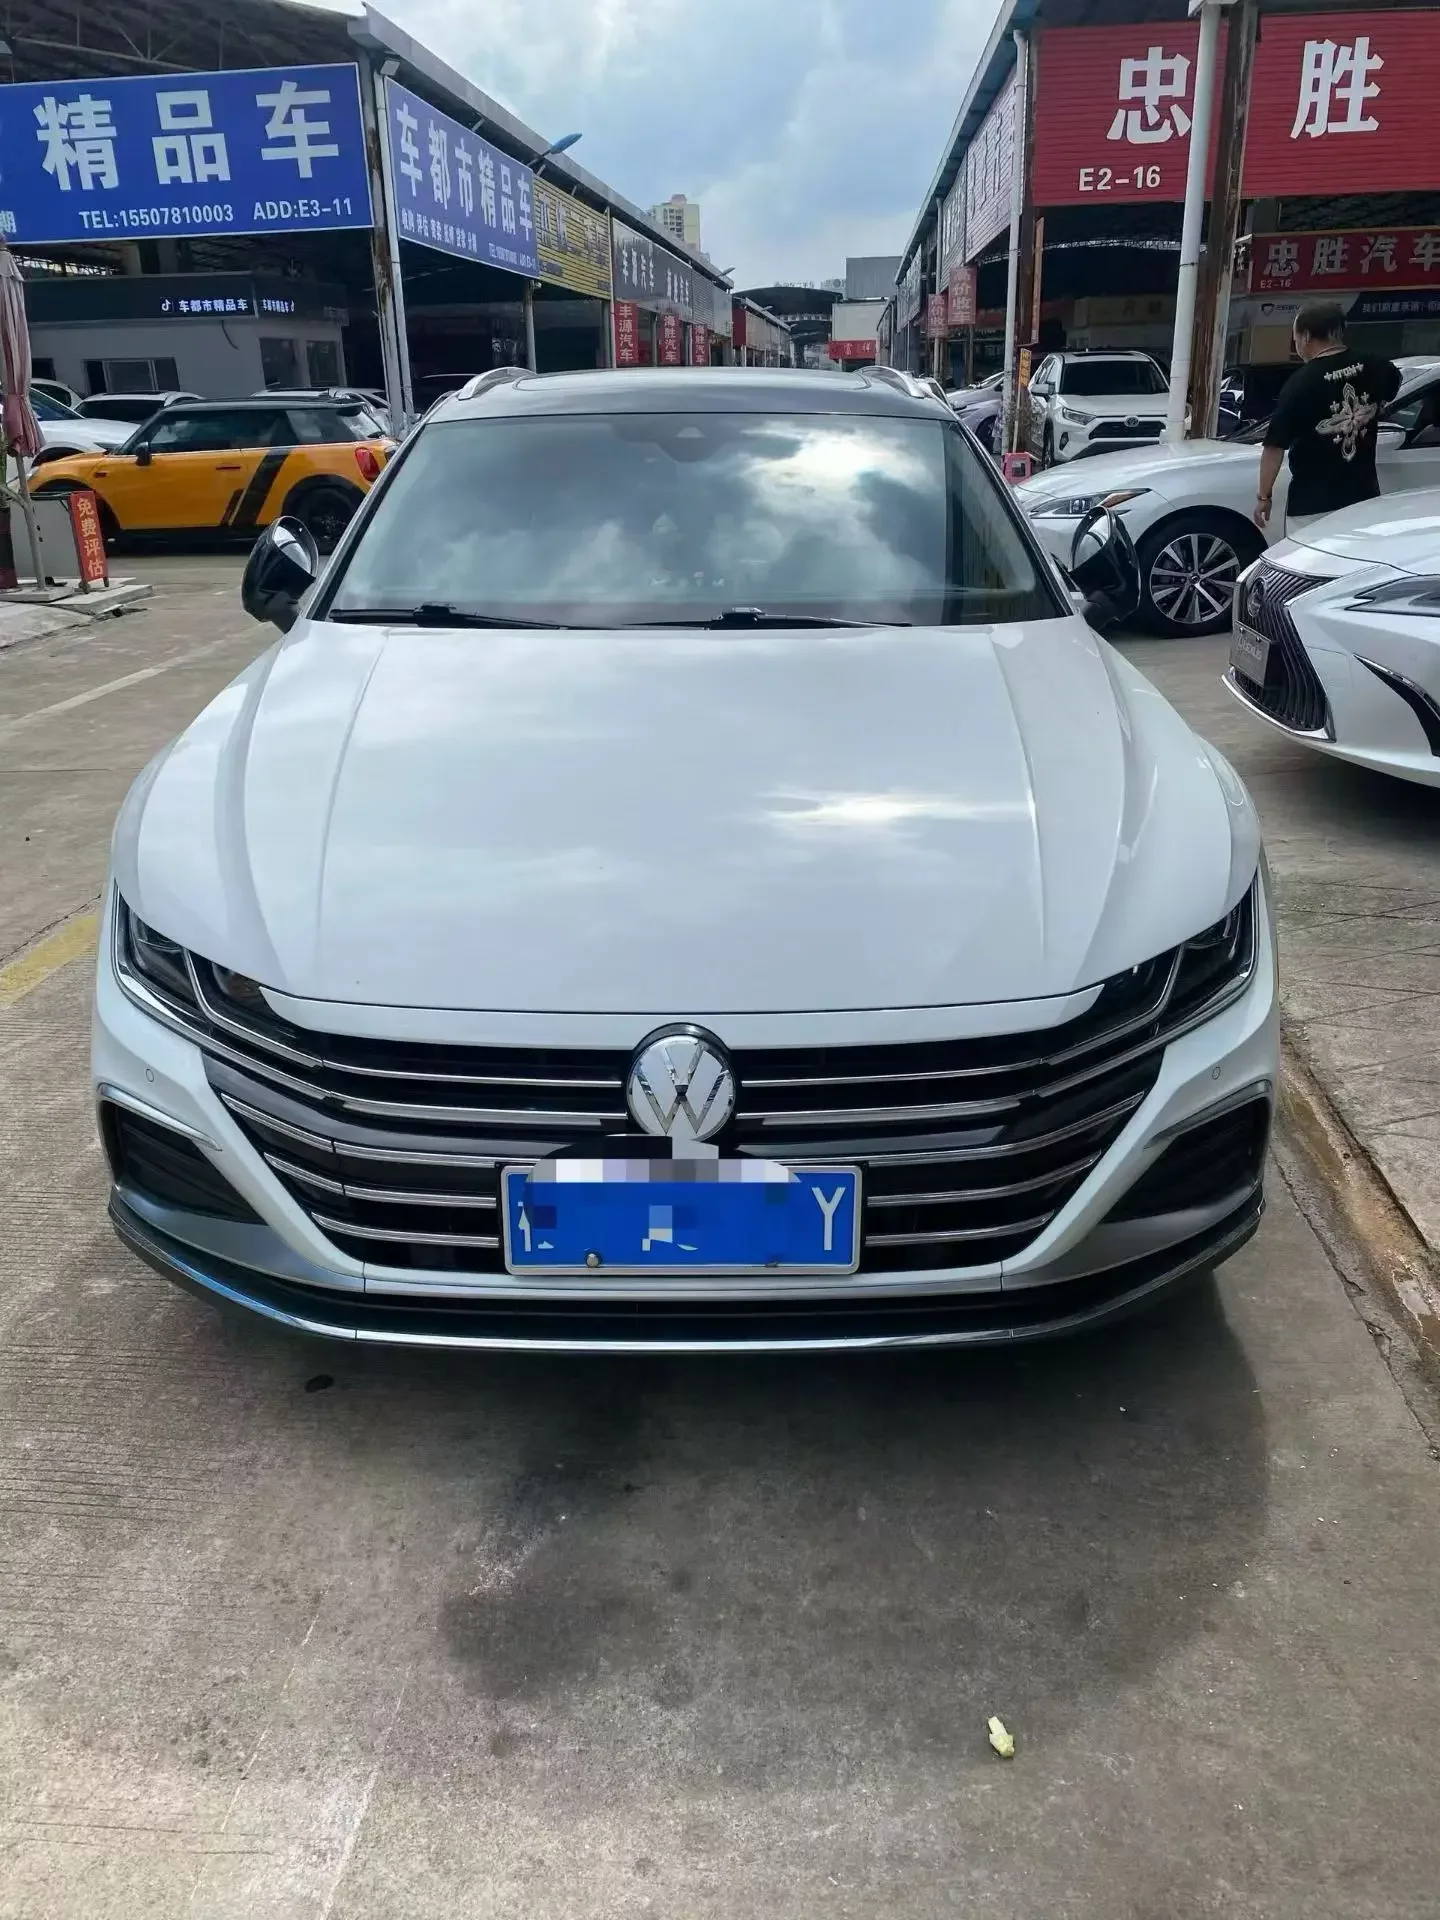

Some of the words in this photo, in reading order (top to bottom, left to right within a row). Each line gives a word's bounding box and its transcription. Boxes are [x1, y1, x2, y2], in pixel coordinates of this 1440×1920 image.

[32, 80, 340, 191] 精品车
[396, 102, 533, 242] 车都市精品车
[1078, 165, 1162, 191] E2-16
[79, 204, 234, 229] TEL:15507810003
[253, 197, 353, 220] ADD:E3-11
[1263, 232, 1440, 277] 忠胜汽车
[178, 297, 248, 313] 车都市精品车
[1260, 278, 1292, 289] E2-16
[618, 304, 634, 362] 丰源汽车
[77, 497, 105, 578] 免费评估
